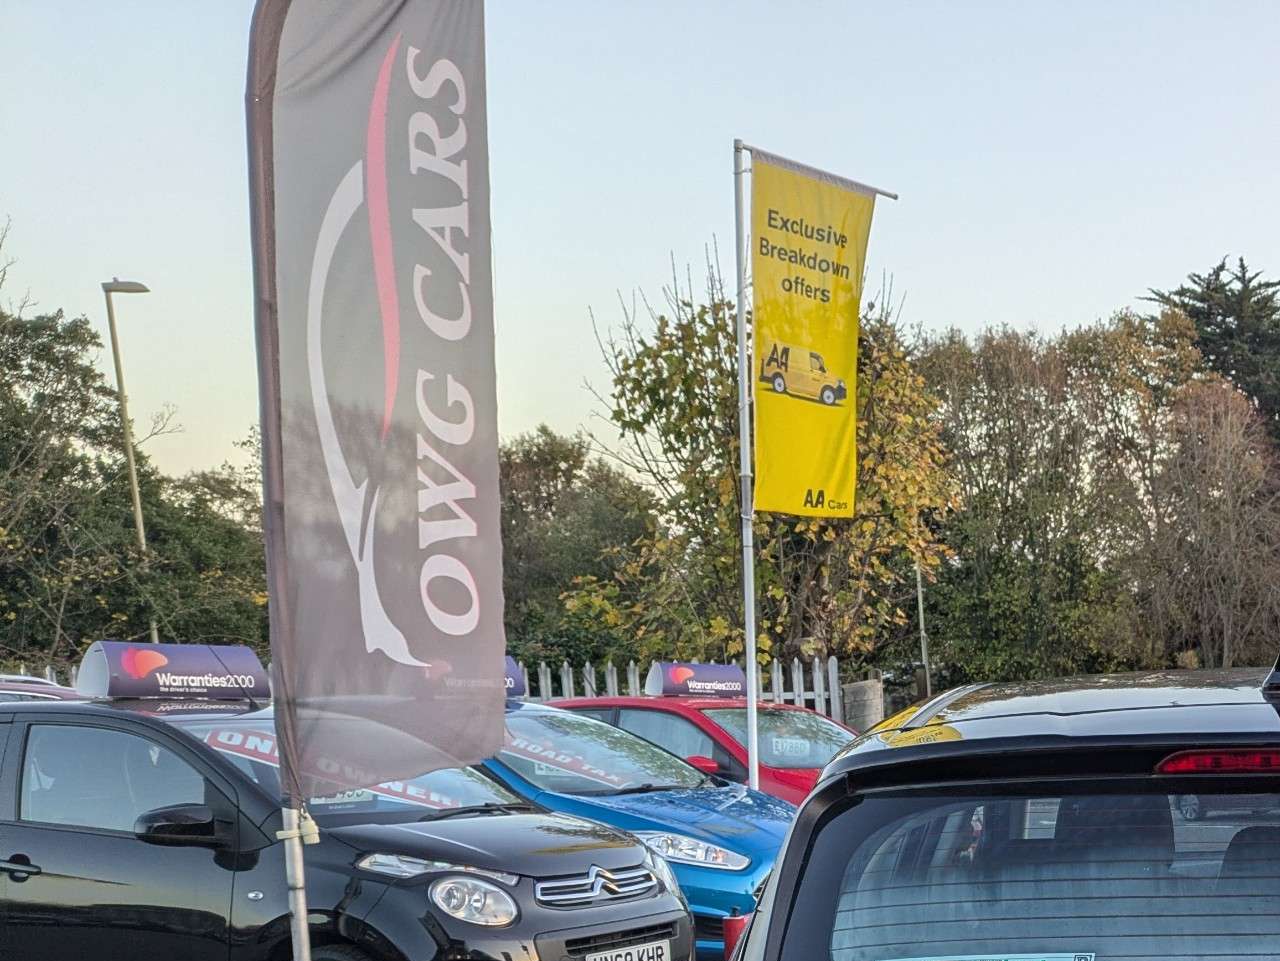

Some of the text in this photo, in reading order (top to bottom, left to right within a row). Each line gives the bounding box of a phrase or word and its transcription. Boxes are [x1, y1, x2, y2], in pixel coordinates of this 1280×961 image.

[406, 44, 473, 343] CARS
[767, 208, 849, 249] Exclusive
[759, 237, 850, 280] Breakdown
[781, 277, 831, 303] offers
[766, 343, 790, 373] AA
[416, 367, 480, 637] OWG
[803, 488, 849, 510] AA Cars
[155, 672, 255, 688] Warranties2000
[687, 680, 742, 691] Warranties2000
[217, 731, 280, 755] ON
[511, 737, 573, 763] ROAD
